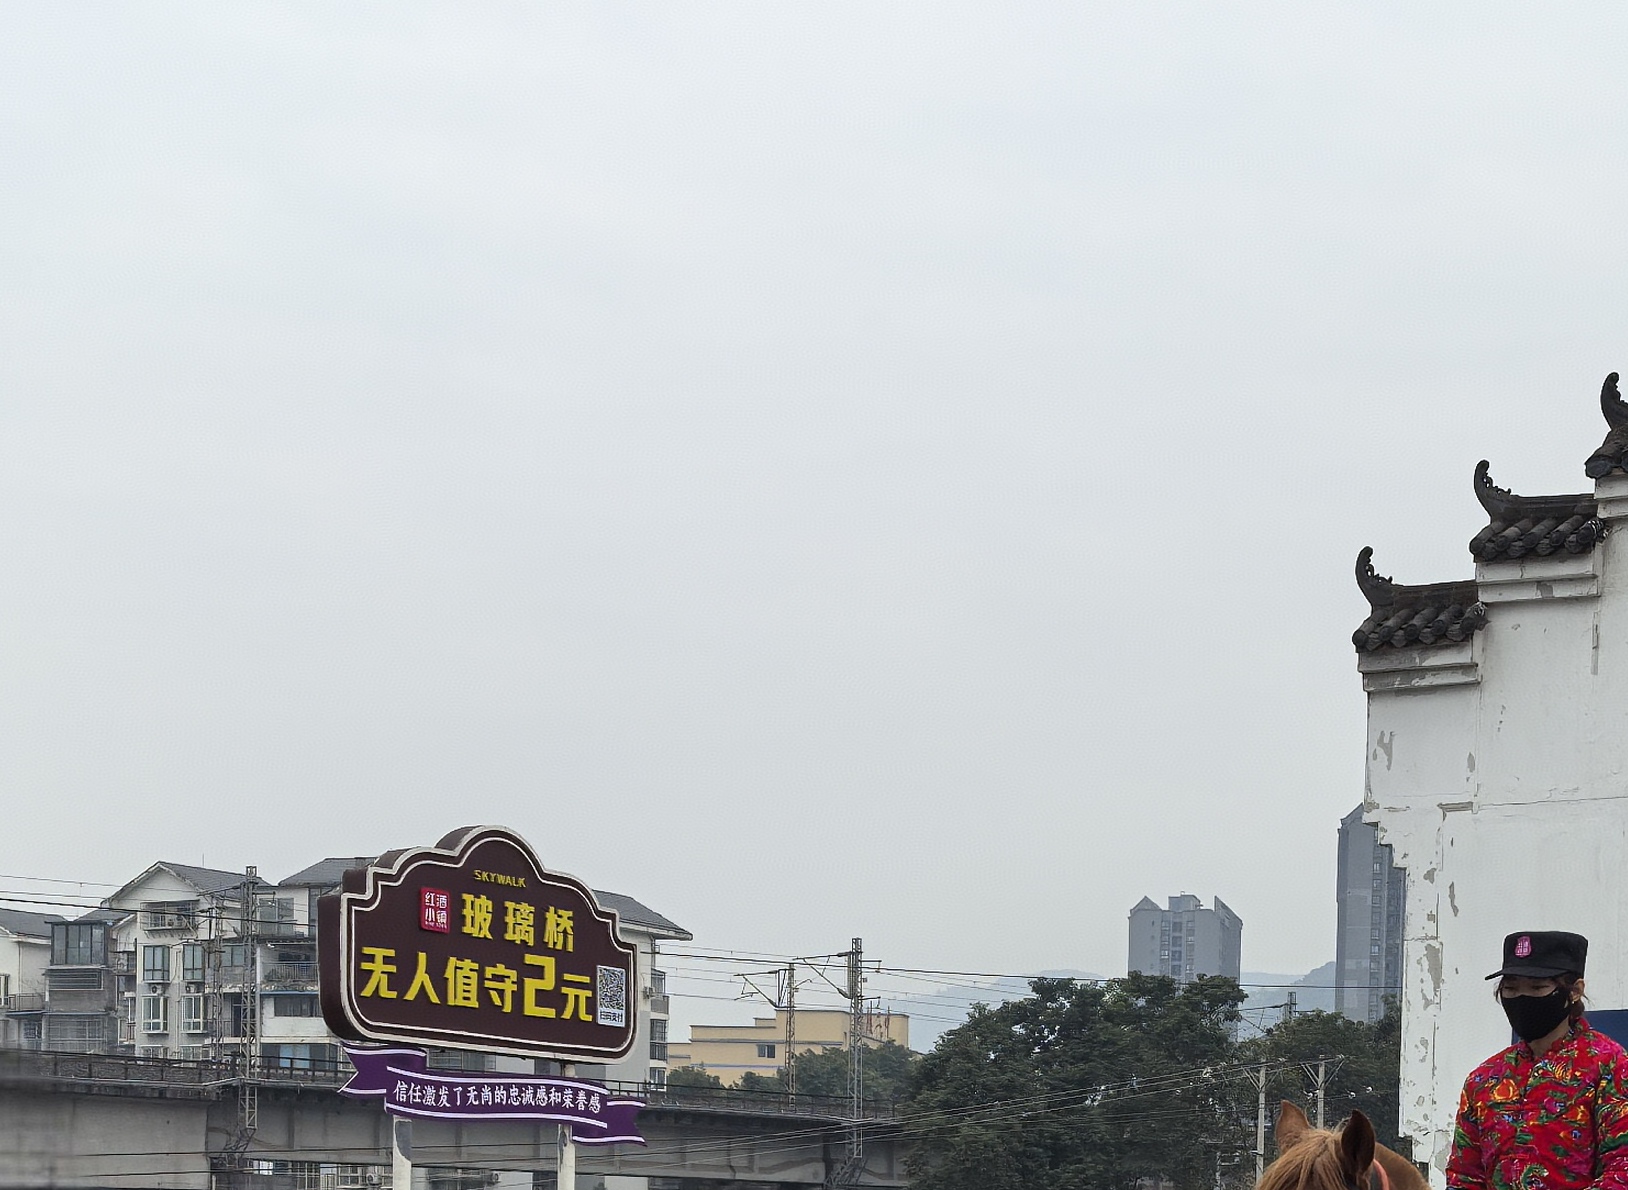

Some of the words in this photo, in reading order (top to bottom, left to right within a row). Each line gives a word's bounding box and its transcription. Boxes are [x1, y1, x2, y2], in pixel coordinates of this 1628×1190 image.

[473, 869, 527, 888] SKYWALK
[461, 892, 574, 953] 玻璃桥
[360, 947, 593, 1022] 无人值守2元
